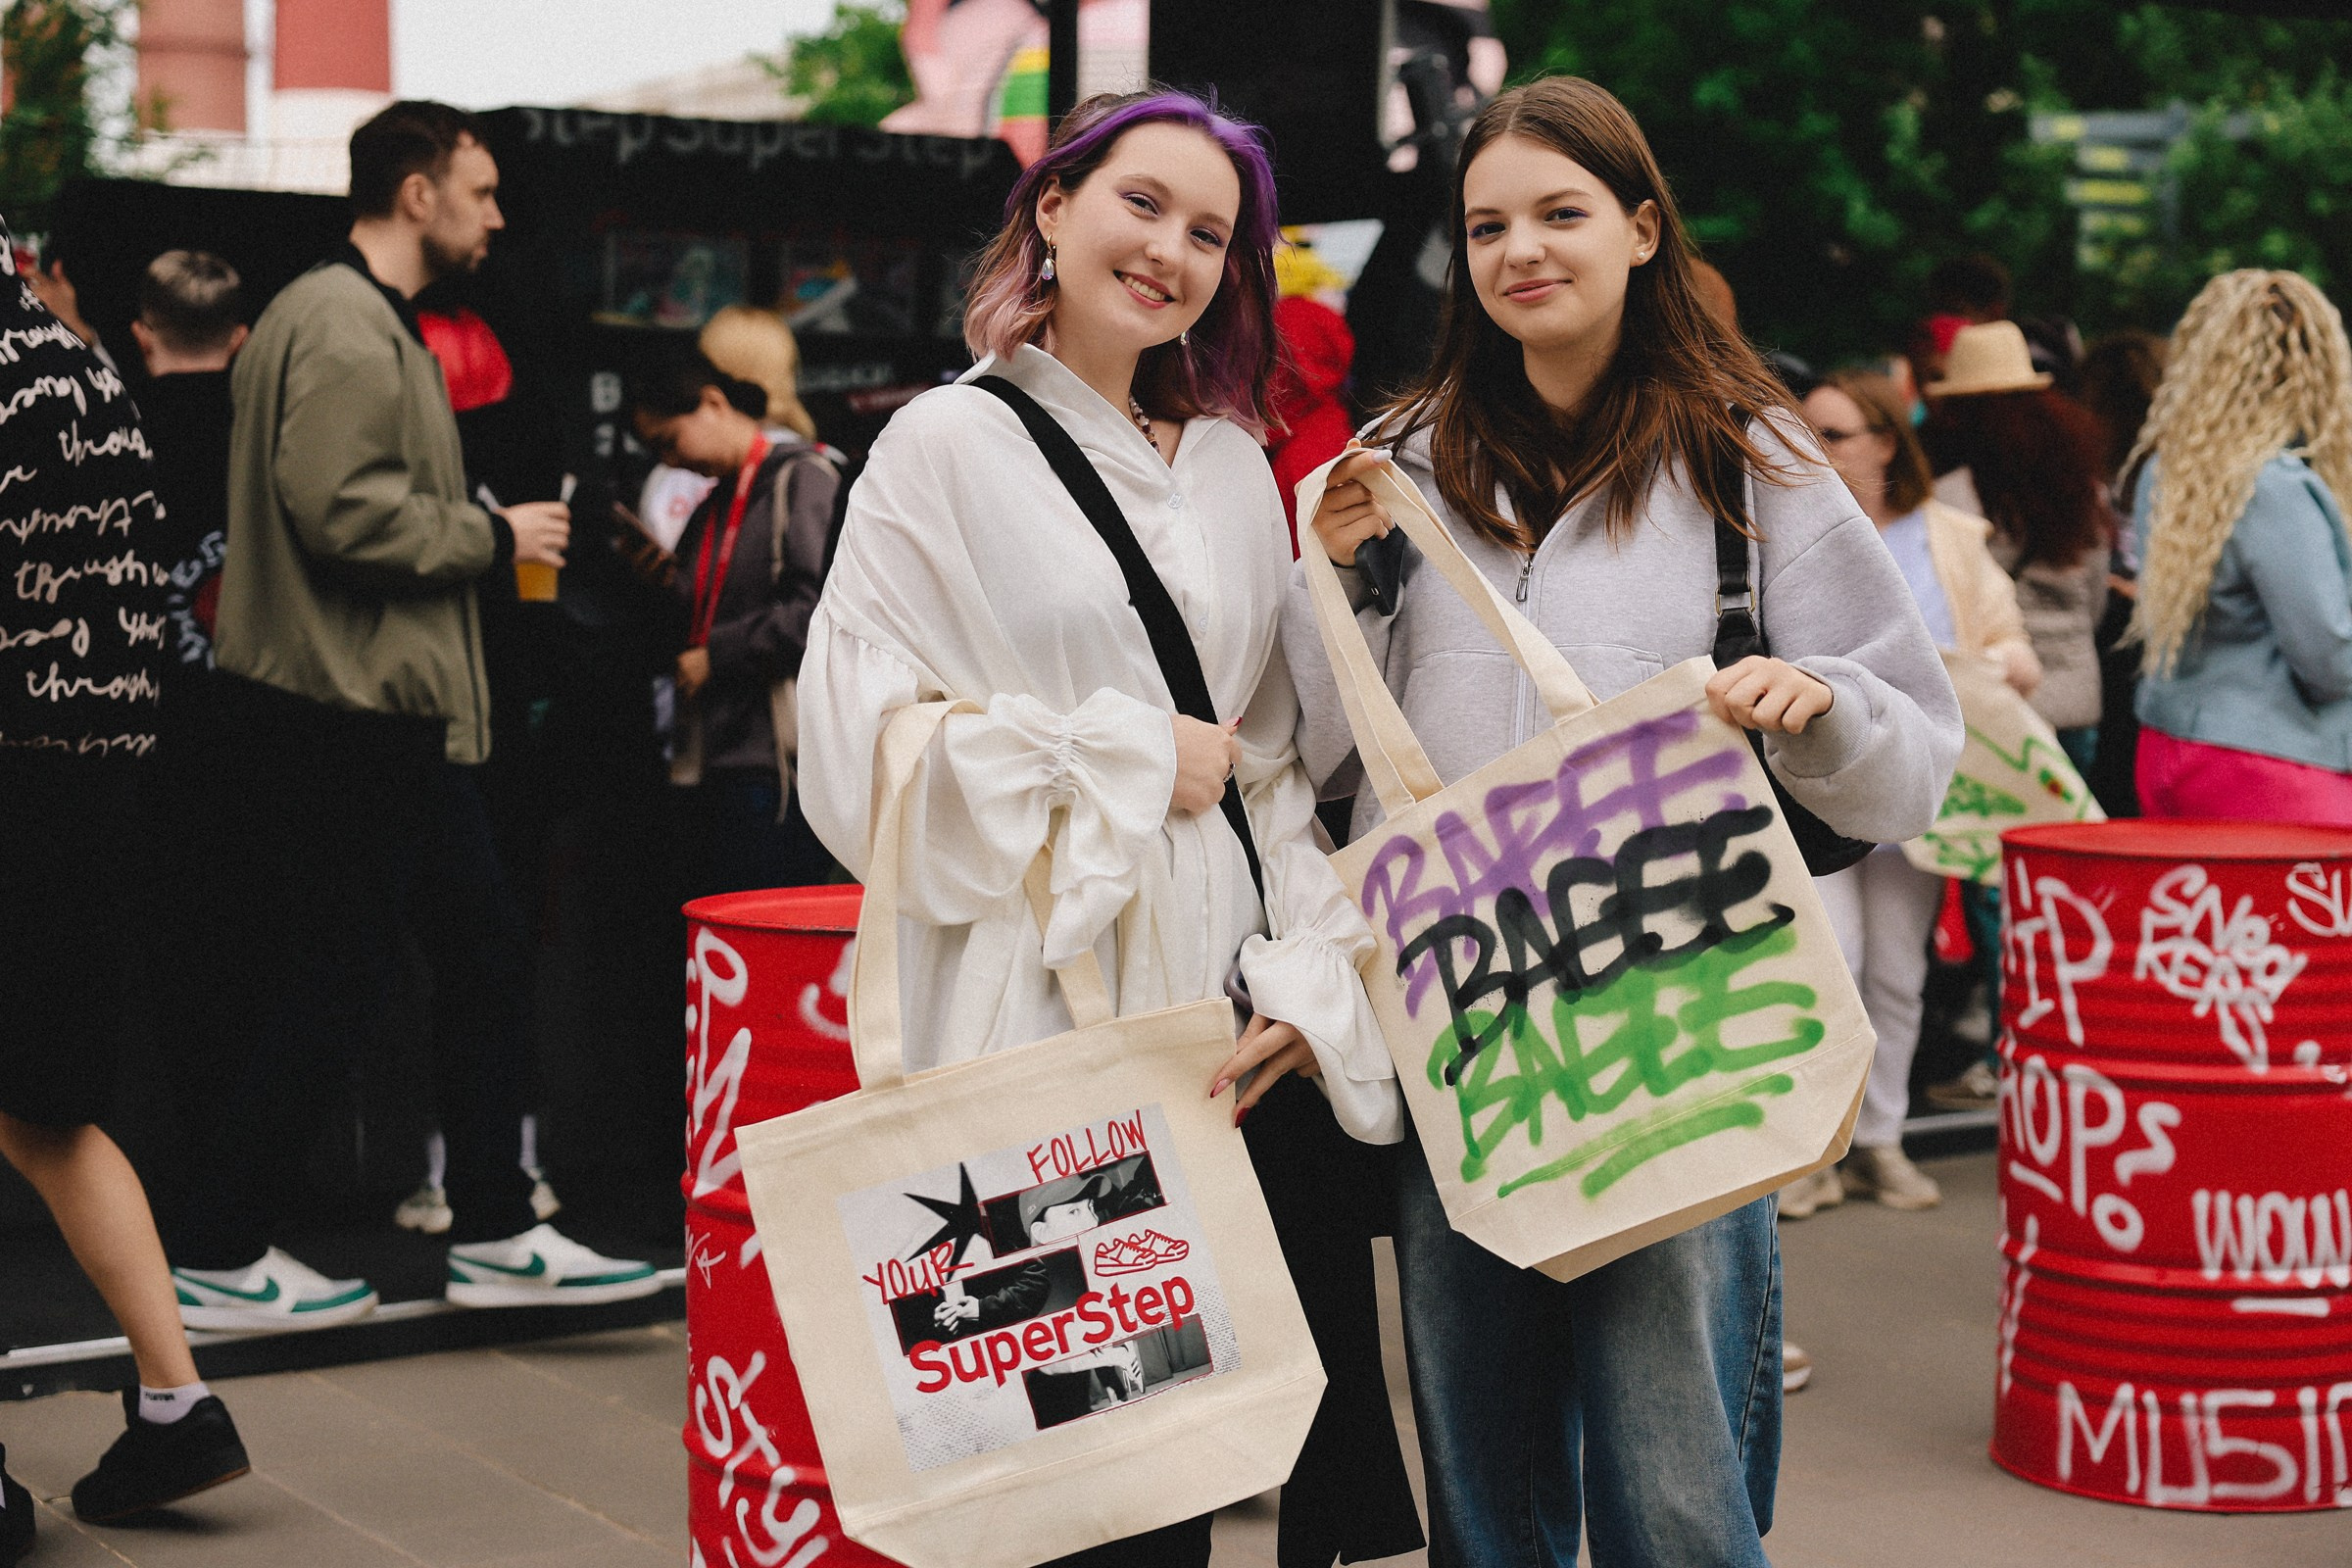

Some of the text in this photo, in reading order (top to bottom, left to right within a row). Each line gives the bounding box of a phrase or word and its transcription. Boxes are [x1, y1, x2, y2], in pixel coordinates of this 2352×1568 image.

[1026, 1108, 1148, 1184] FOLLOW
[862, 1240, 975, 1305] YOUR
[908, 1275, 1195, 1394] SuperStep
